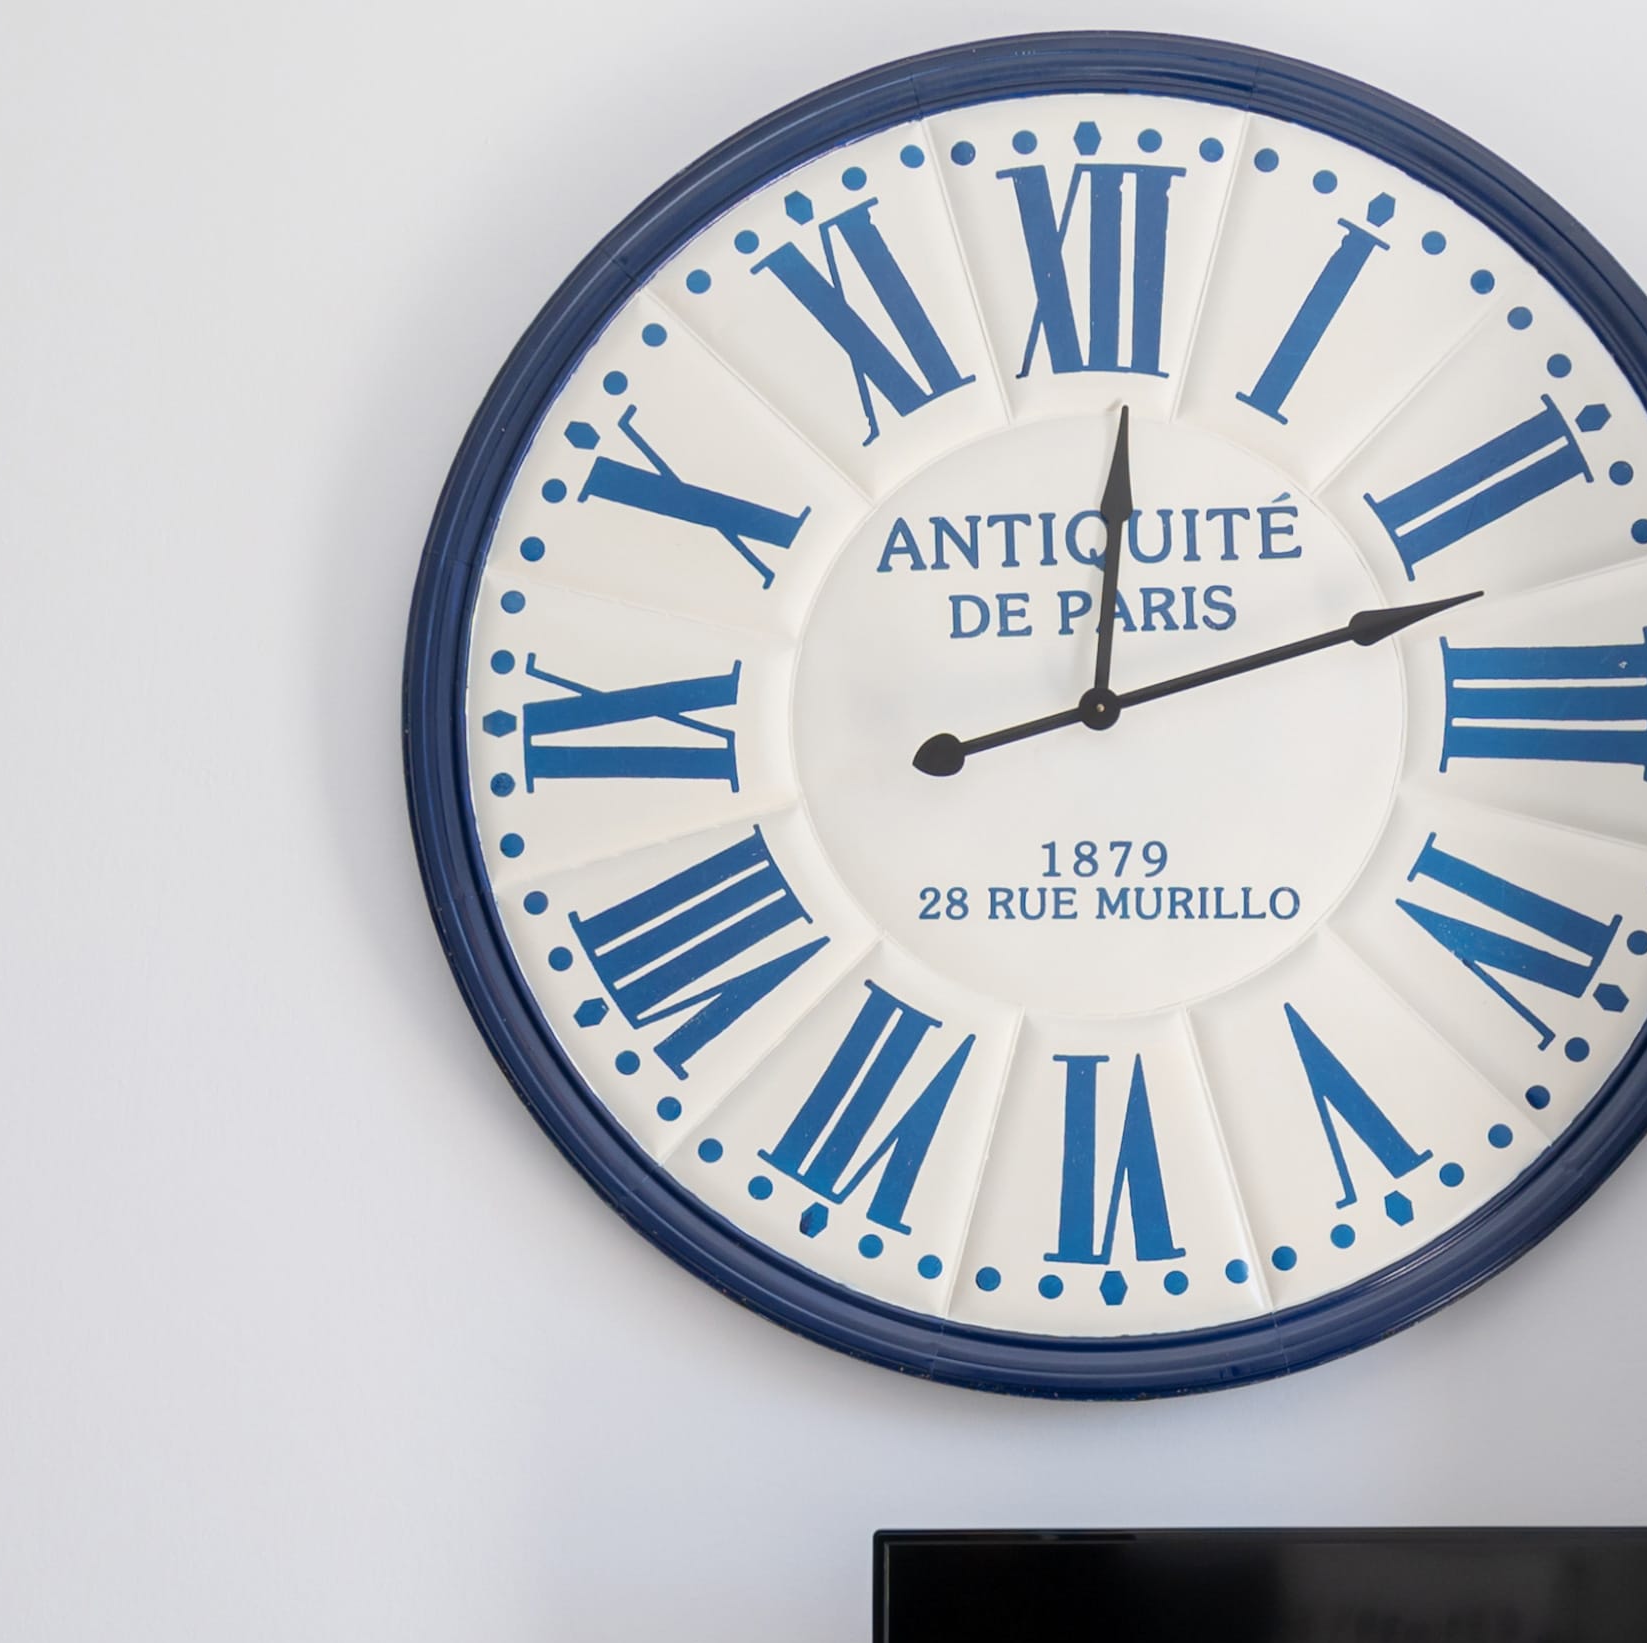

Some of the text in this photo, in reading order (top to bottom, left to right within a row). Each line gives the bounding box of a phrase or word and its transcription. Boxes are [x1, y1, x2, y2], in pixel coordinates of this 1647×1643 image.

[749, 197, 976, 447] XI
[995, 163, 1187, 379] XII
[1235, 218, 1391, 426] I
[576, 404, 812, 590] X
[876, 492, 1303, 574] ANTIQUITÉ
[1362, 394, 1594, 582] II
[948, 592, 1033, 639] DE
[521, 651, 743, 794] IX
[567, 826, 831, 1081] VIII
[918, 887, 1301, 920] 28 RUE MURILLO
[1040, 841, 1169, 878] 1879
[1394, 831, 1623, 1051] IV
[756, 980, 977, 1237] VII
[1041, 1054, 1187, 1266] VI
[1283, 1002, 1434, 1211] V
